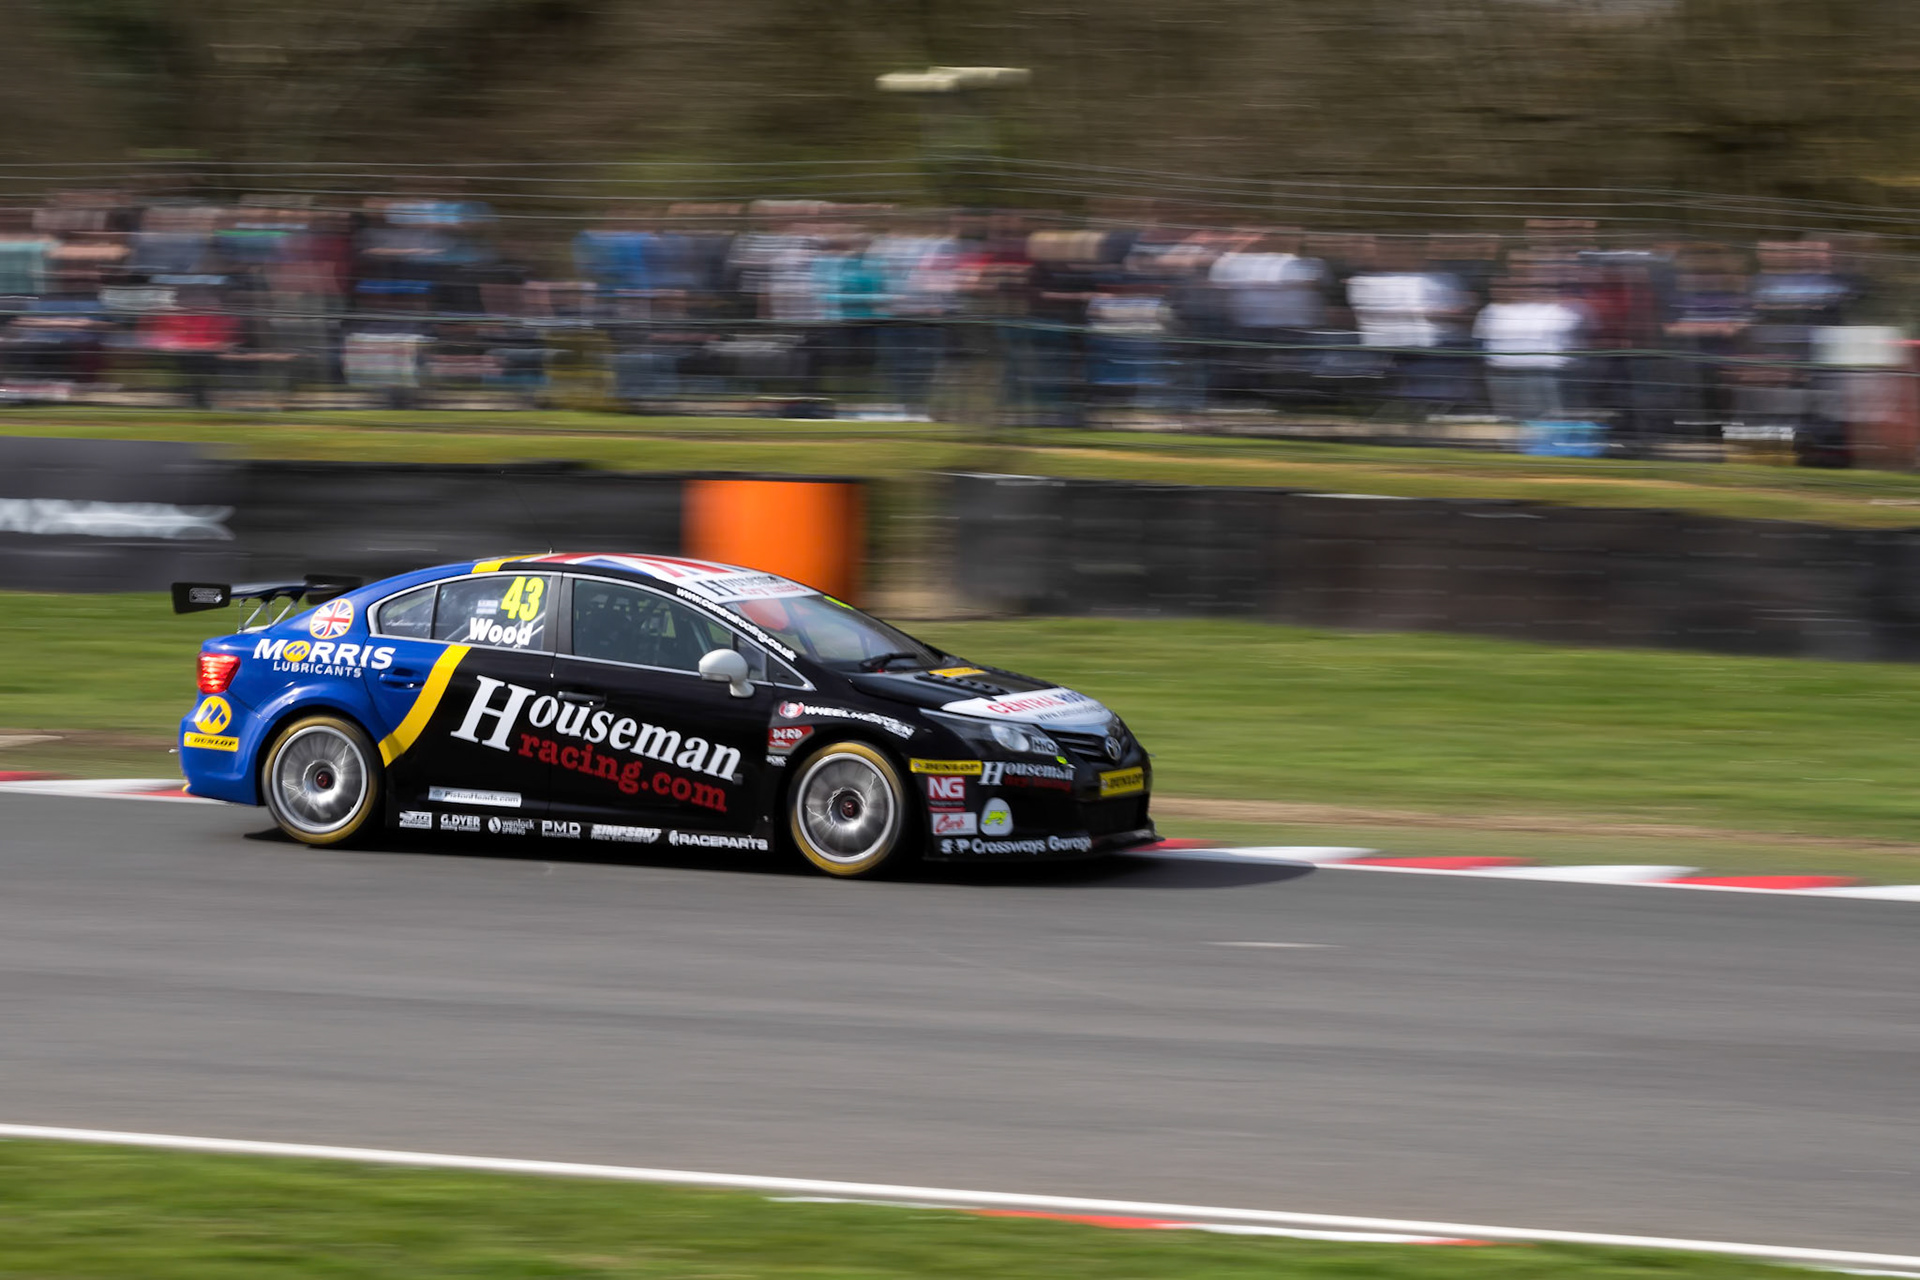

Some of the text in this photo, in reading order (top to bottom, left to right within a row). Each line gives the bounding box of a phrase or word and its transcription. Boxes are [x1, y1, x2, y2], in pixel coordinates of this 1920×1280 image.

[501, 576, 545, 621] 43
[469, 617, 534, 646] Wood
[253, 638, 396, 670] MORRIS
[273, 661, 362, 678] LUBRICANTS
[987, 696, 1066, 714] CENTRAL
[450, 675, 741, 781] Houseman
[193, 737, 236, 747] DUNLOP
[517, 733, 727, 812] racing.com
[924, 762, 979, 773] DUNLOP
[978, 761, 1073, 786] Houseman
[929, 777, 964, 798] NG
[1108, 774, 1143, 788] DUNLOP
[441, 814, 480, 829] G.DYER
[542, 820, 581, 834] PMD
[679, 834, 768, 851] RACEPARTS
[971, 837, 1047, 855] Crossways
